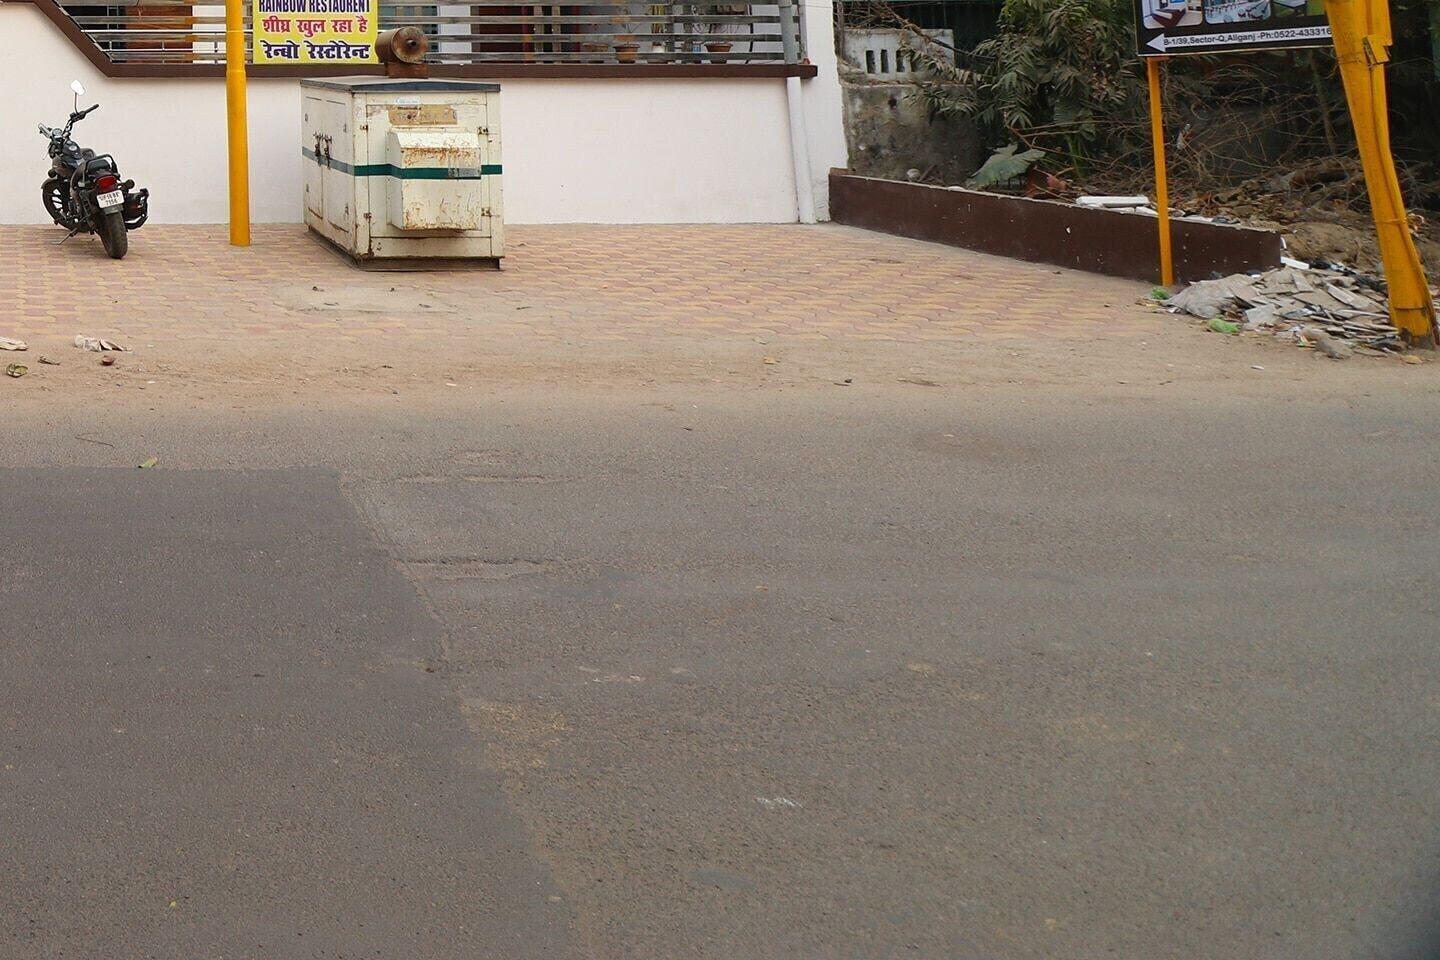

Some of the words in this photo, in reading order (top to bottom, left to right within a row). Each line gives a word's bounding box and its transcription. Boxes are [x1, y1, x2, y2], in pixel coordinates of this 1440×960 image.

[262, 16, 291, 33] शीघ्र
[296, 19, 326, 37] खुल
[331, 19, 352, 33] रहा
[356, 16, 368, 33] है
[260, 40, 300, 58] रेन्बो
